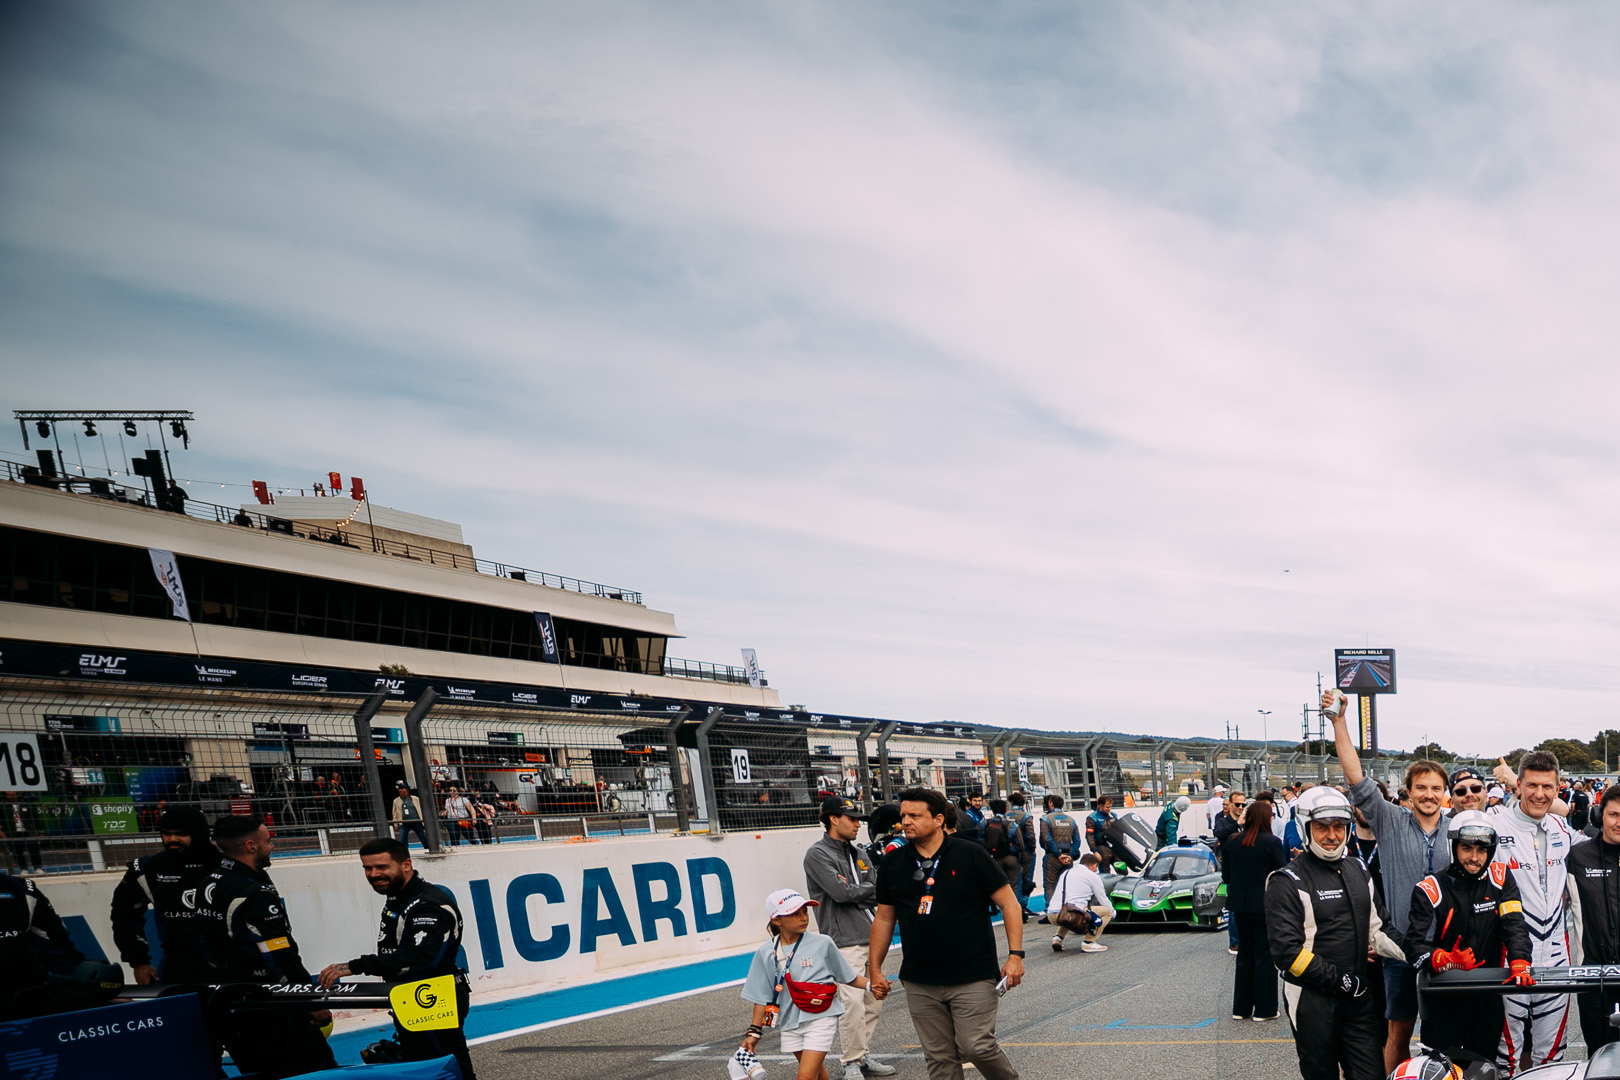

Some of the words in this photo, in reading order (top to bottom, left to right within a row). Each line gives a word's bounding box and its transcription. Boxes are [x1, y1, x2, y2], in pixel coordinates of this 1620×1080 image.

[79, 655, 127, 668] ELMS
[208, 667, 237, 676] MICHELIN
[0, 742, 41, 787] 18
[733, 754, 748, 780] 19
[103, 805, 133, 815] shopify
[406, 1014, 435, 1026] CLASSIC
[436, 1010, 455, 1020] CARS
[58, 1023, 121, 1043] CLASSIC
[126, 1016, 165, 1032] CARS
